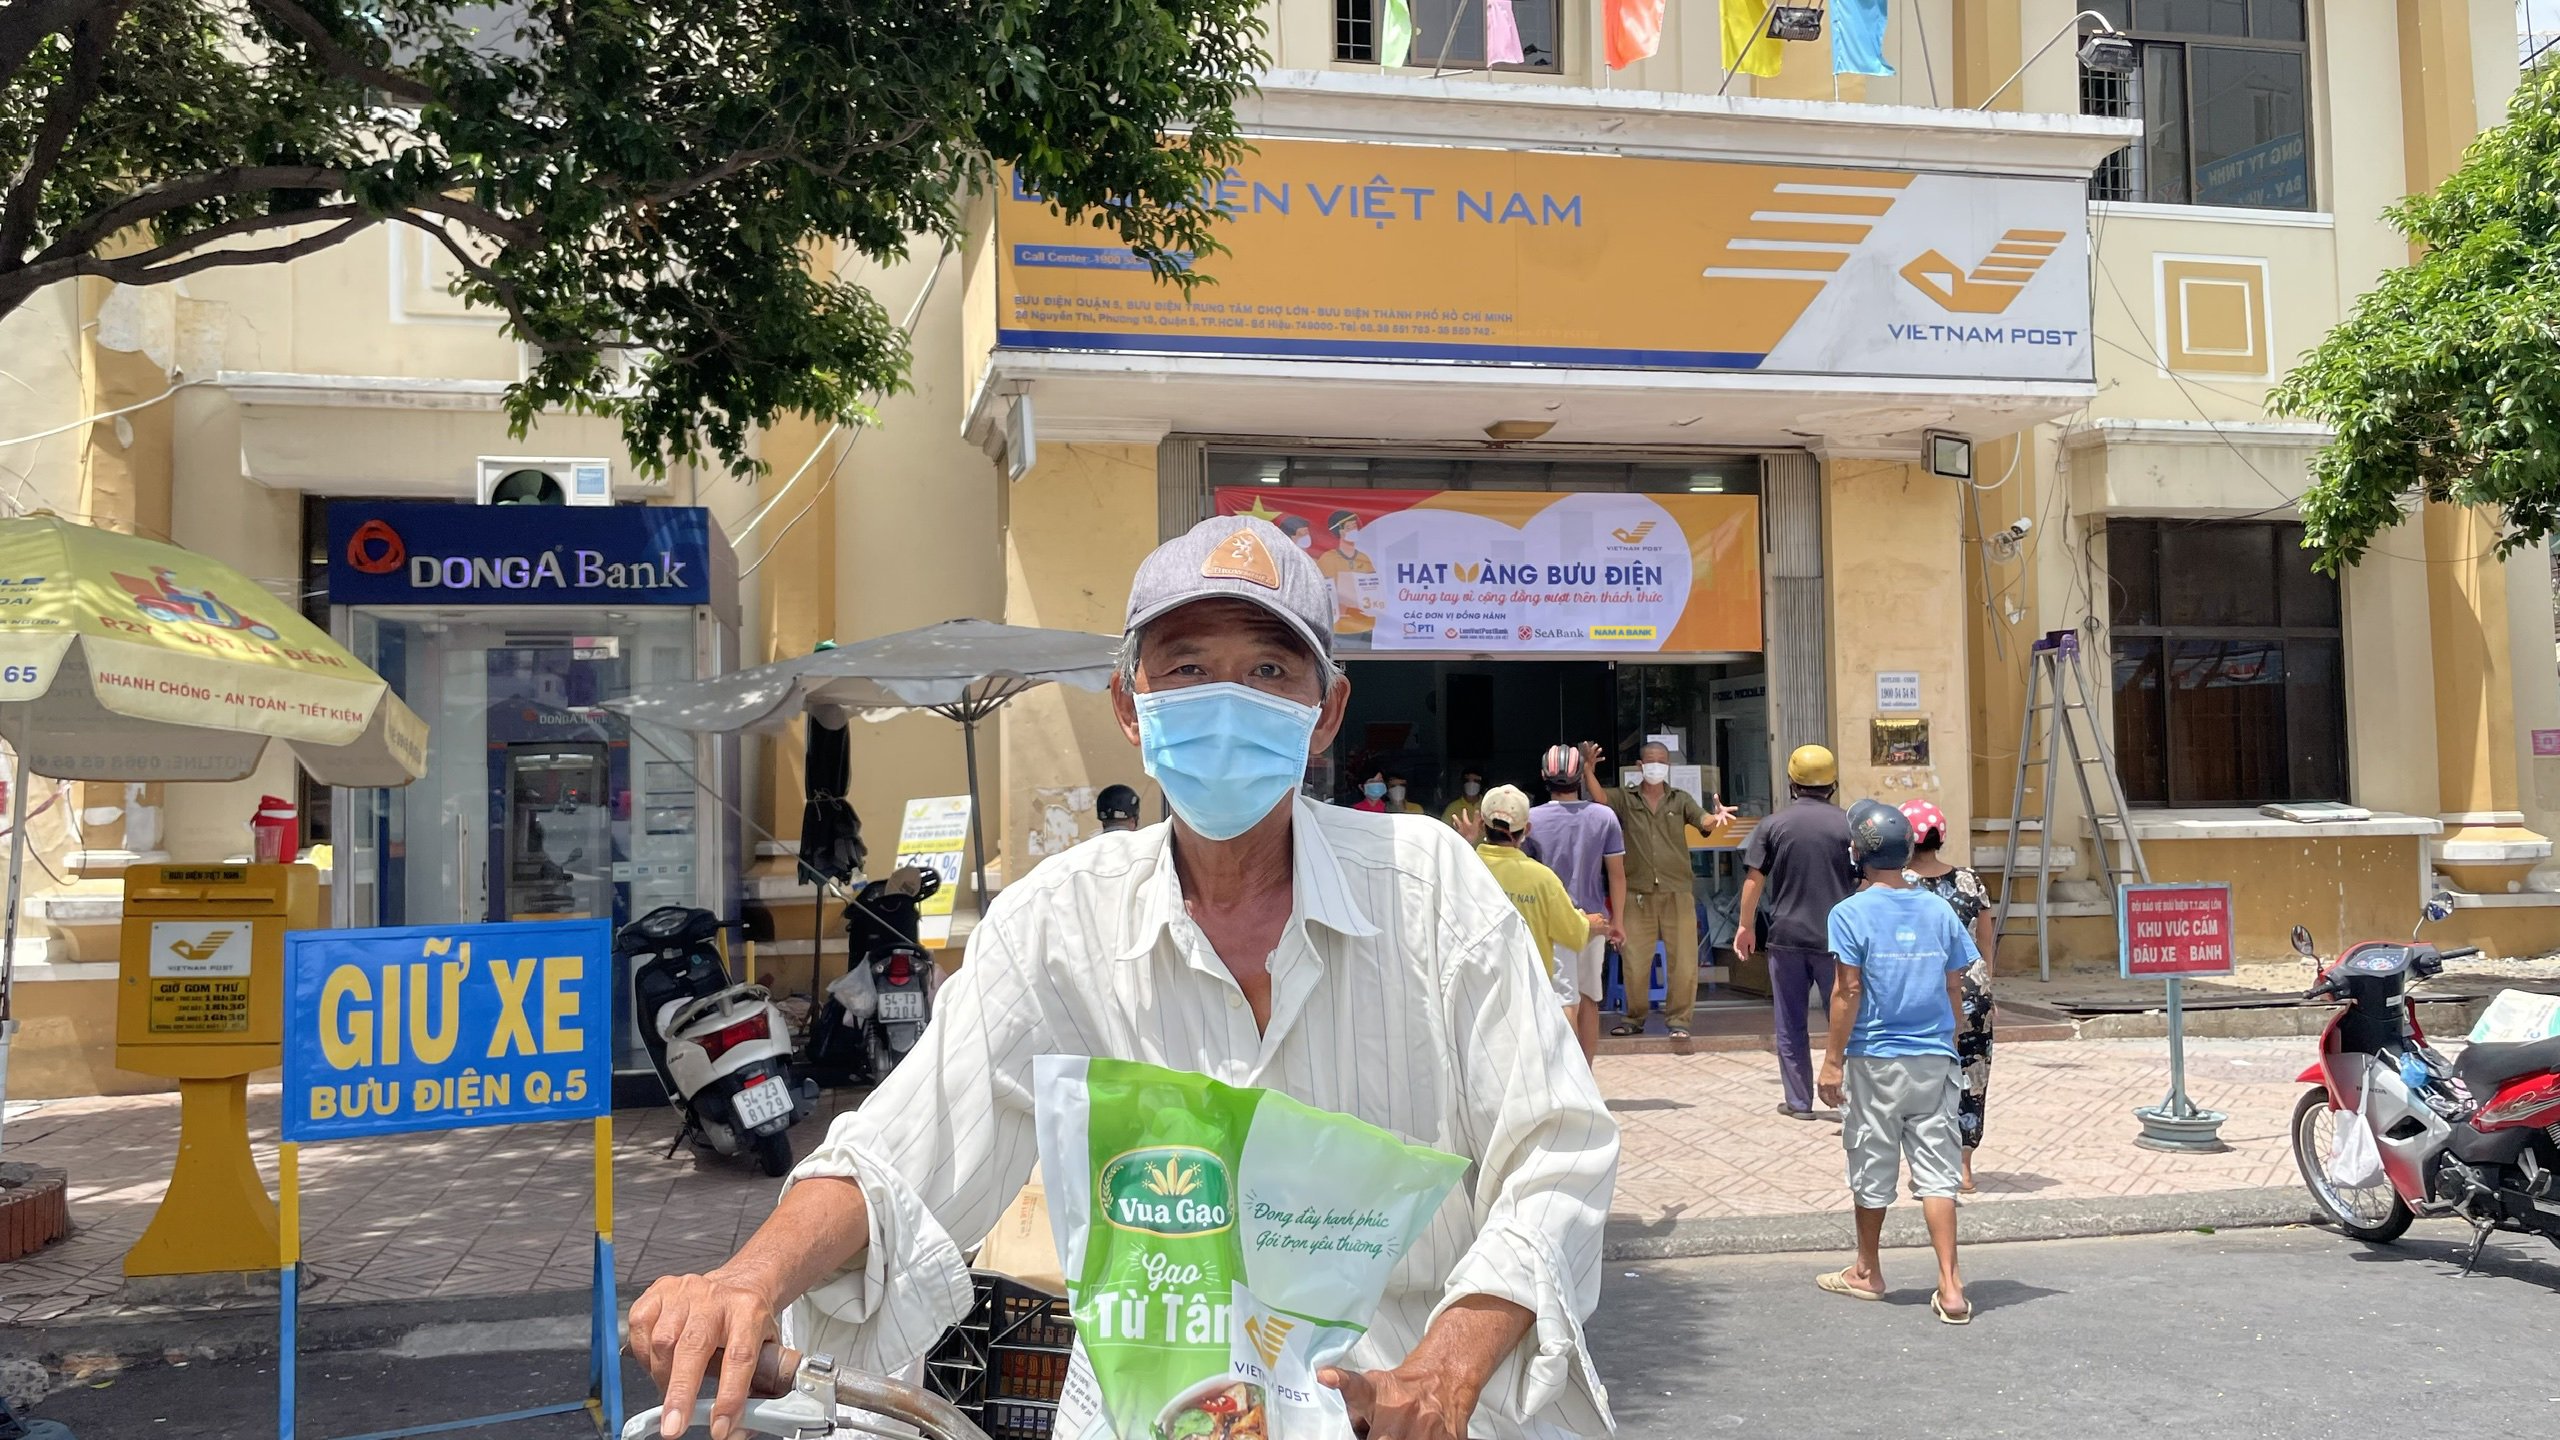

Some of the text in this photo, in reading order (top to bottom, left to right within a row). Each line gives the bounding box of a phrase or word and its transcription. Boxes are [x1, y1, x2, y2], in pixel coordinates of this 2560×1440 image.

[1304, 173, 1436, 229] VIỆT
[1456, 190, 1583, 228] NAM
[1021, 250, 1045, 261] Call
[1186, 302, 1225, 314] TRUNG
[1485, 313, 1514, 323] MINH
[1887, 323, 2078, 347] VIETNAM POST
[574, 548, 689, 590] Bank
[1397, 562, 1449, 590] HẠT
[1547, 561, 1596, 586] BƯU
[1604, 560, 1663, 591] ĐIỆN
[1398, 587, 1438, 606] Chung
[1440, 590, 1459, 607] tay
[1573, 590, 1598, 603] trên
[1600, 589, 1635, 604] thách
[100, 615, 152, 636] R2Y
[1418, 624, 1435, 633] PTI
[1534, 628, 1585, 639] SeABank
[1594, 628, 1617, 637] NAM
[1617, 629, 1625, 637] A
[1626, 628, 1652, 637] BANK
[4, 665, 38, 684] 65
[99, 671, 156, 692] NHANH
[159, 680, 211, 702] CHÓNG
[224, 691, 245, 706] AN
[247, 693, 287, 712] TOÀN
[298, 700, 328, 718] TIẾT
[330, 708, 363, 724] KIỆM
[1517, 893, 1536, 904] NAM
[2136, 920, 2163, 938] KHU
[2160, 945, 2177, 963] XE
[184, 983, 211, 993] GOM
[318, 937, 585, 1072] GIỮ XE
[310, 1067, 588, 1121] BƯU ĐIỆN Q.5
[2356, 1086, 2388, 1095] HNDA
[748, 1099, 786, 1123] 8129
[1117, 1197, 1226, 1228] Vua Gạo
[1322, 1207, 1355, 1230] hạnh
[1352, 1209, 1390, 1232] phúc
[1256, 1230, 1384, 1260] Gói trọn yêu thương
[1141, 1252, 1203, 1292] Gạo
[1095, 1288, 1150, 1340] Từ
[1277, 1385, 1311, 1403] POST
